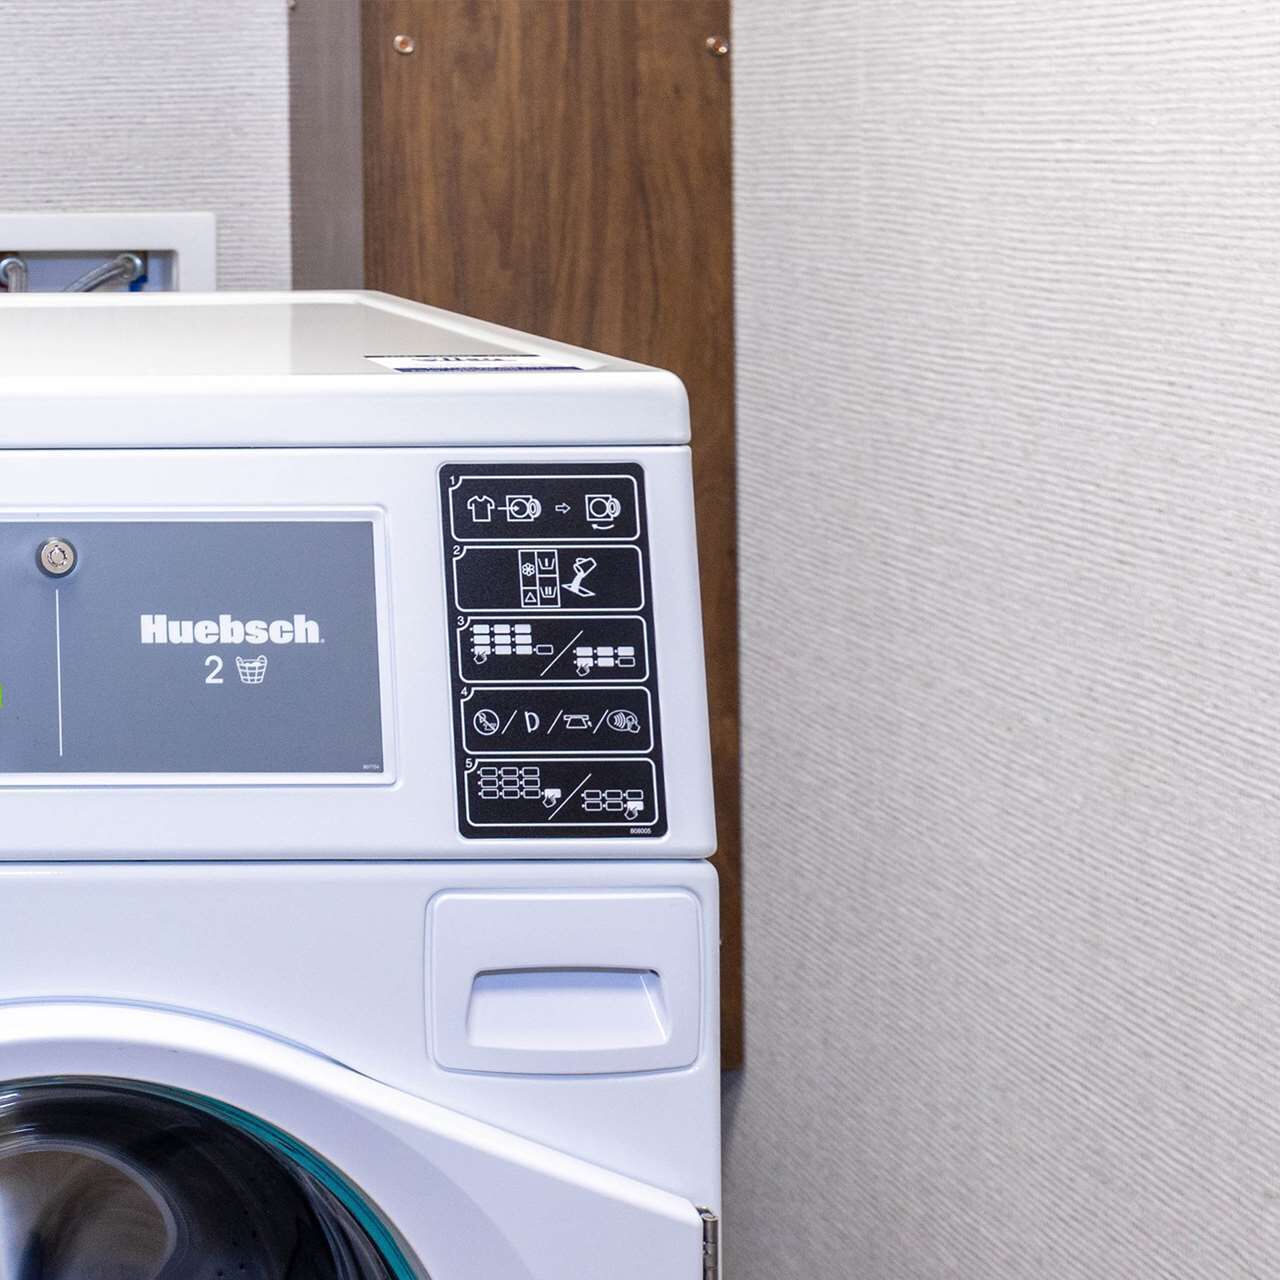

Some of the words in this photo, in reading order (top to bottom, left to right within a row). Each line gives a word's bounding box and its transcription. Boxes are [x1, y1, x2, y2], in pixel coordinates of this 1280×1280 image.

[450, 476, 455, 485] 1
[453, 545, 461, 555] 2
[457, 616, 465, 625] 3
[140, 614, 320, 644] Huebsch
[204, 655, 224, 684] 2
[461, 687, 468, 696] 4
[465, 759, 473, 768] 5
